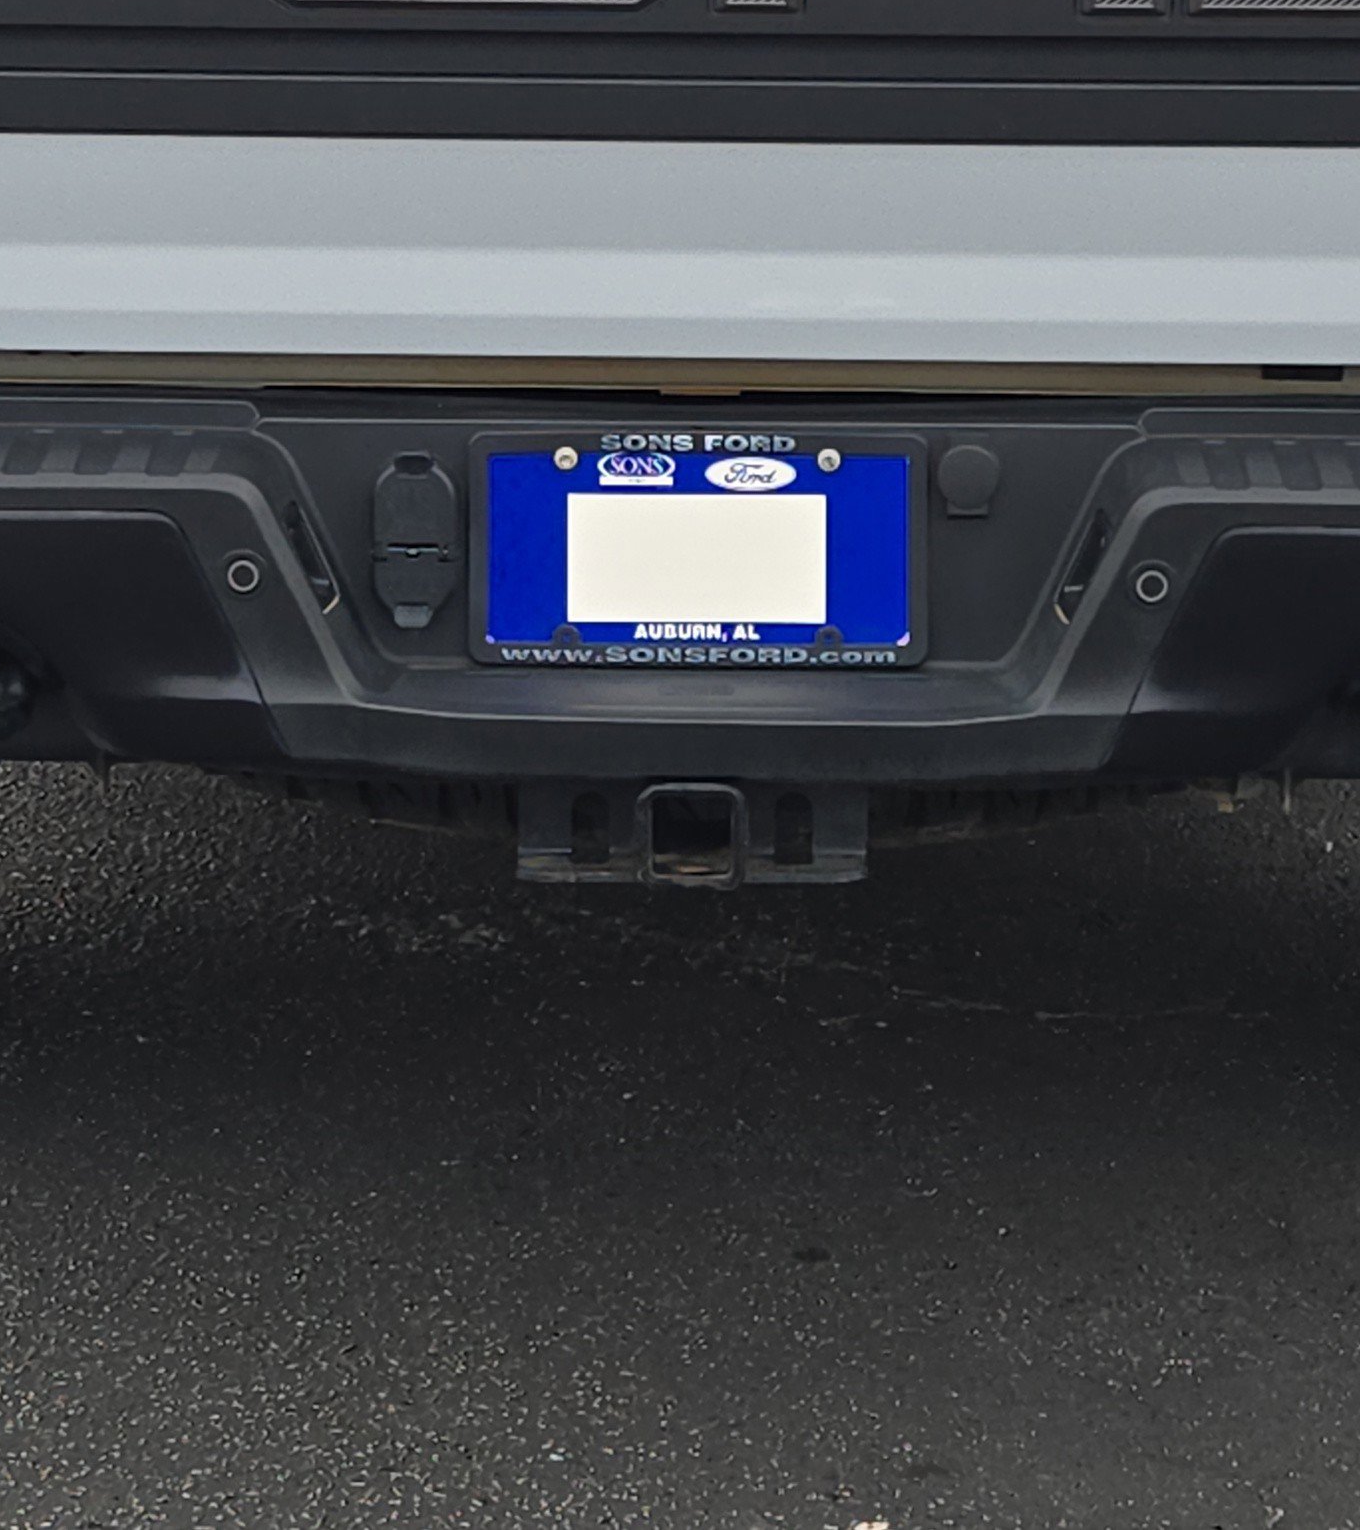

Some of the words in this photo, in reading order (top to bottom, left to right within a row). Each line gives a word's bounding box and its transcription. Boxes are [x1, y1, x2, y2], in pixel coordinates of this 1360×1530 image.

[600, 434, 694, 452] SONS
[704, 434, 797, 452] FORD
[610, 454, 665, 477] SONS
[724, 461, 777, 485] Ford
[633, 623, 728, 643] AUBURN,
[732, 623, 761, 641] AL
[500, 645, 897, 664] www.SONSFORD.com
